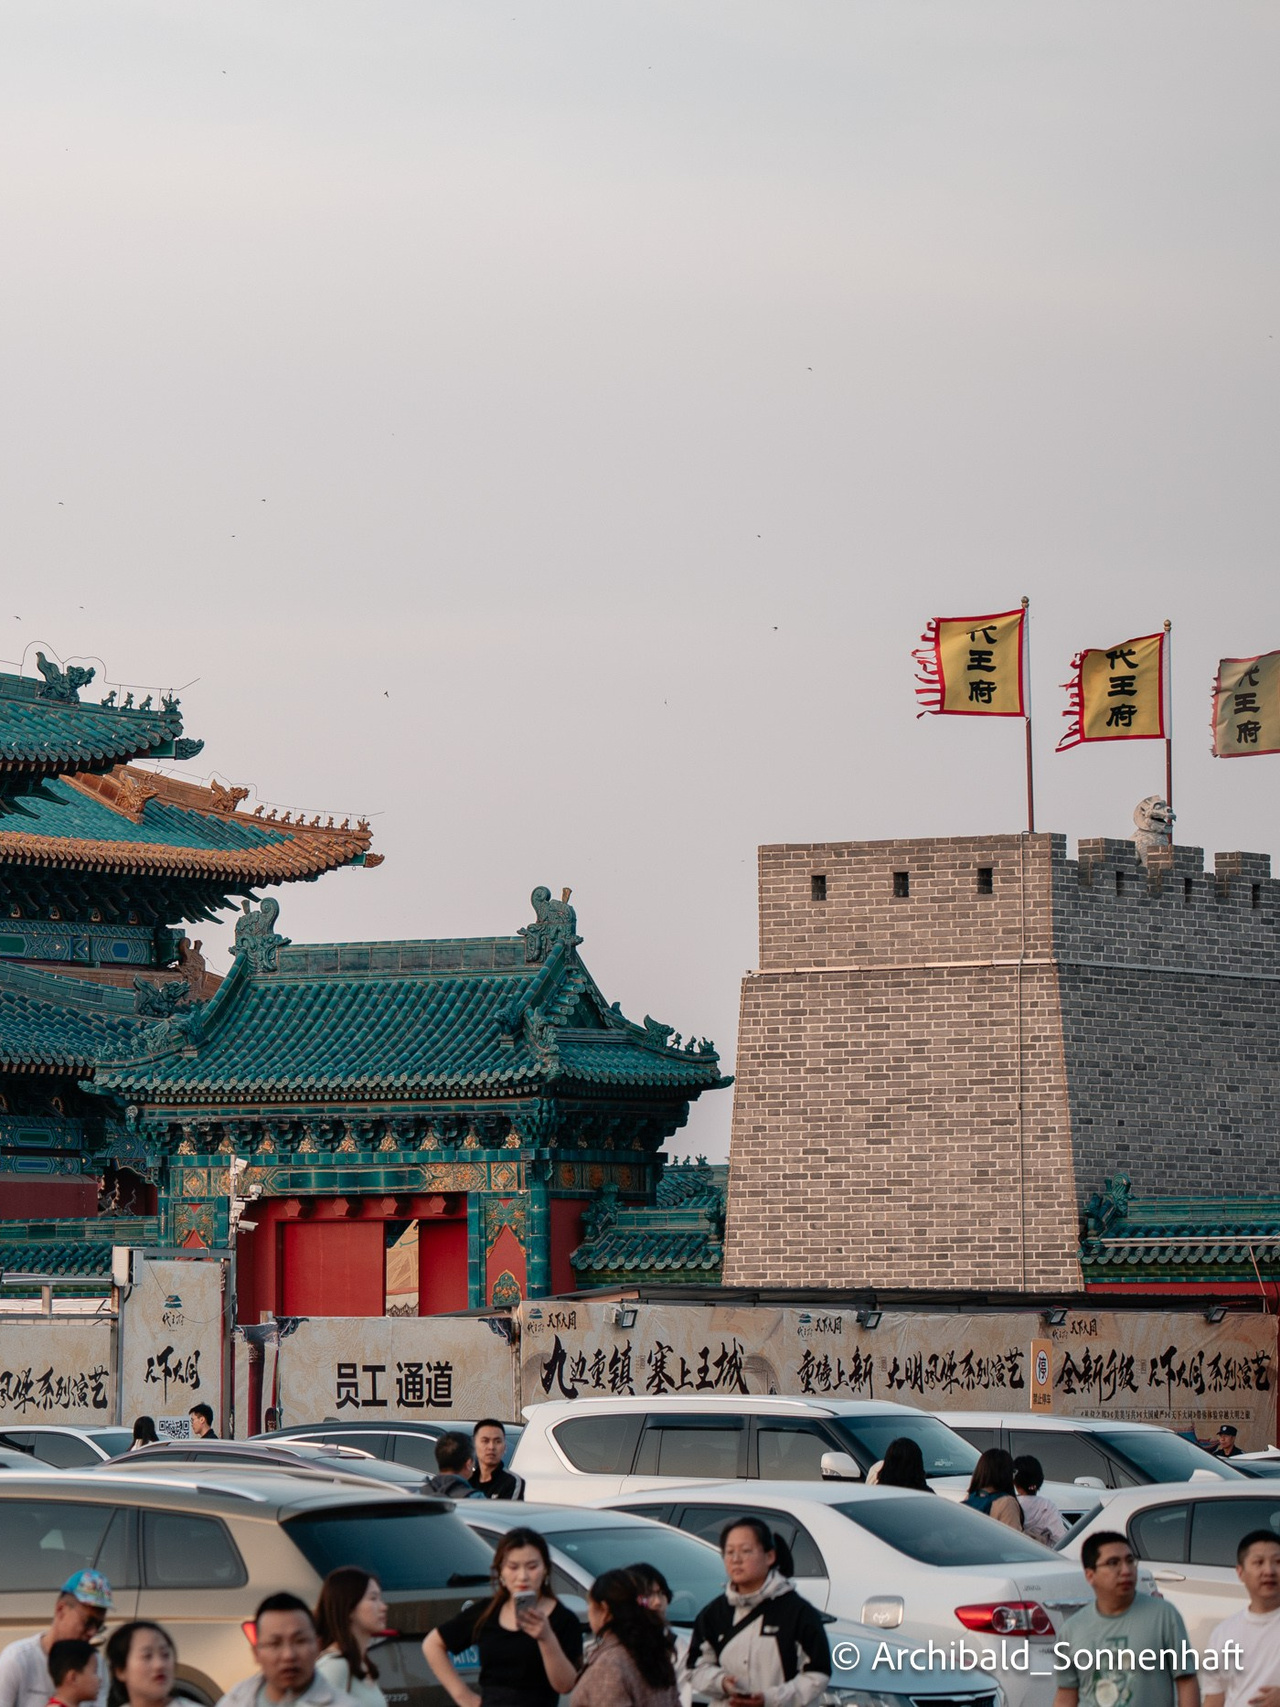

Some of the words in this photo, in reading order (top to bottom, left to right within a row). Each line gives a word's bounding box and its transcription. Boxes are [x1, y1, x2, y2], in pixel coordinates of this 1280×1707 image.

[966, 625, 997, 704] 代王府
[1106, 648, 1139, 728] 代王府
[1234, 665, 1261, 744] 代王府
[162, 1311, 185, 1327] 代王府
[144, 1346, 200, 1405] 天下大同
[541, 1334, 635, 1399] 九边重镇
[646, 1337, 749, 1395] 塞上王城
[797, 1346, 873, 1399] 重磅上新
[1053, 1347, 1139, 1406] 全新升级
